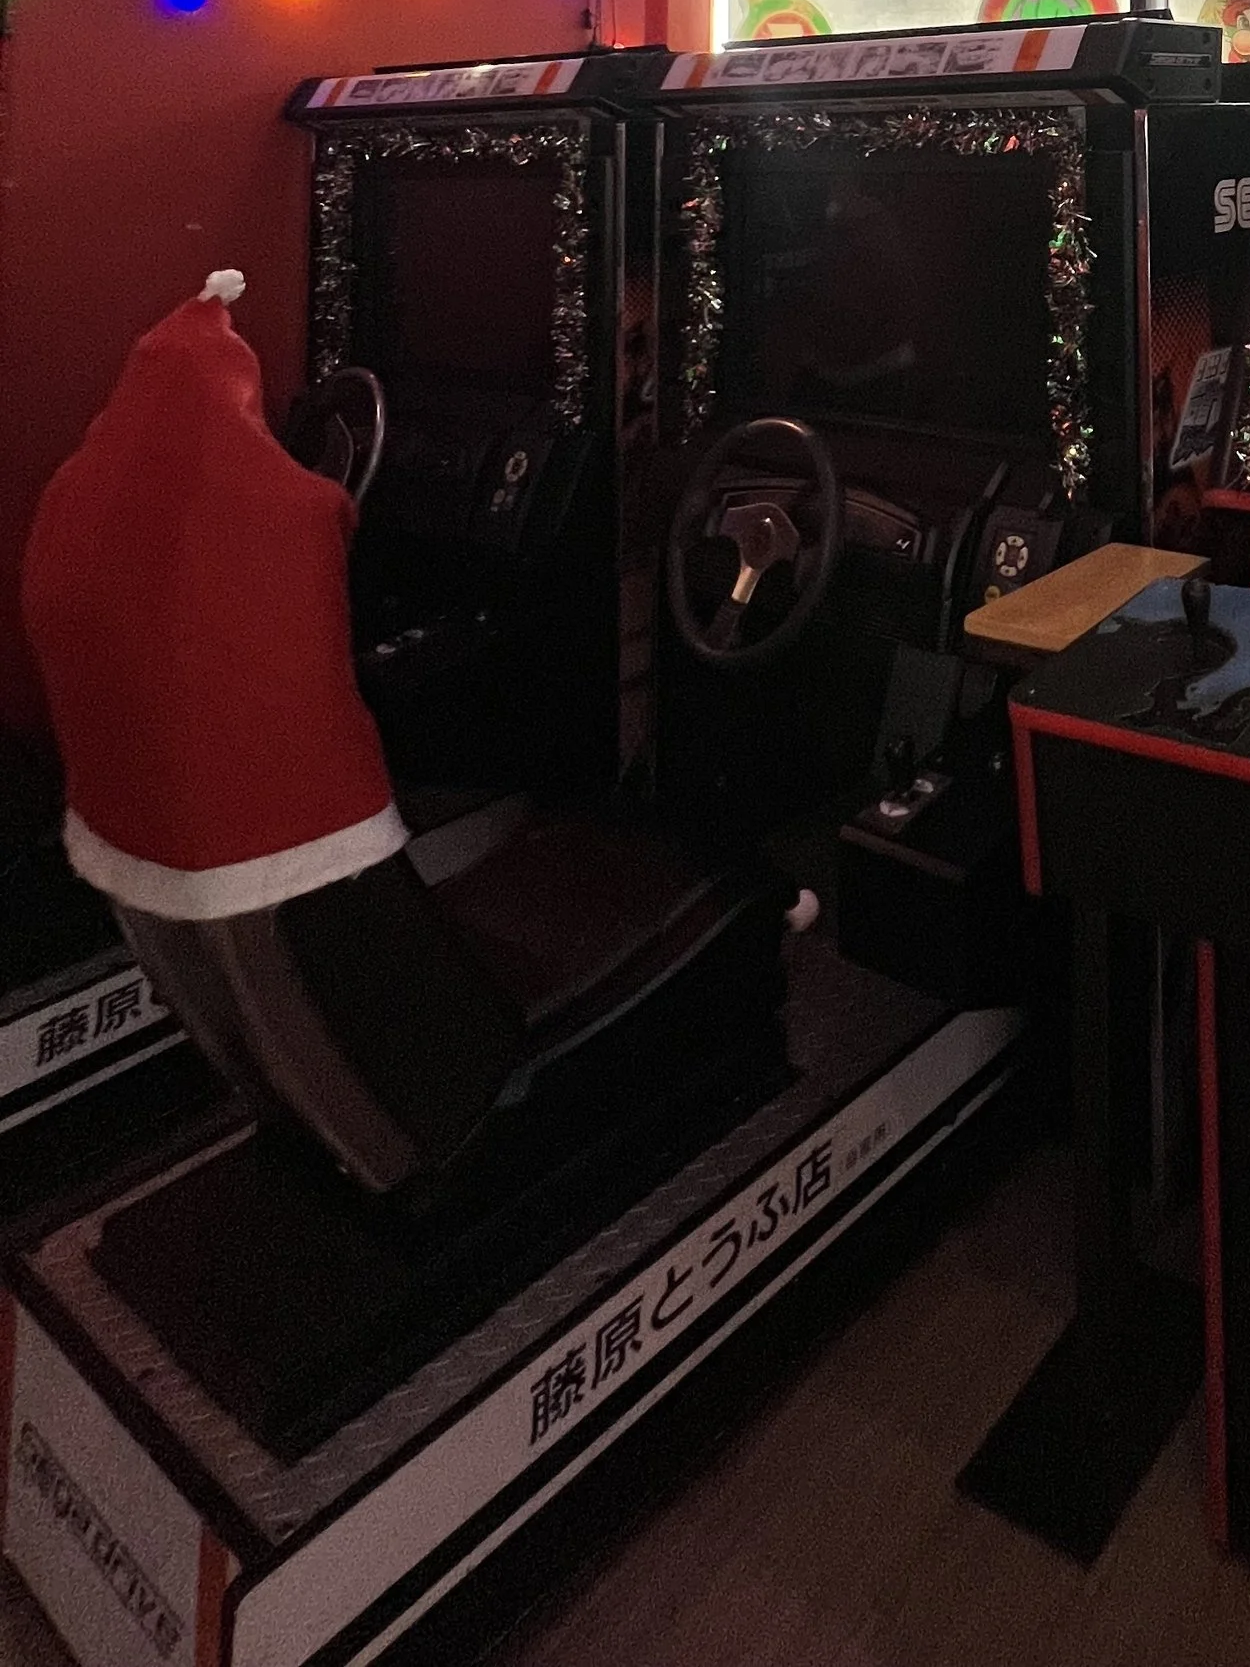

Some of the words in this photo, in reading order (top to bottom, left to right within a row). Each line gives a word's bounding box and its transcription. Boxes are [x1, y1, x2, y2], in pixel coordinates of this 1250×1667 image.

[36, 978, 165, 1067] 藤原
[529, 1139, 832, 1445] 藤原とうふ店
